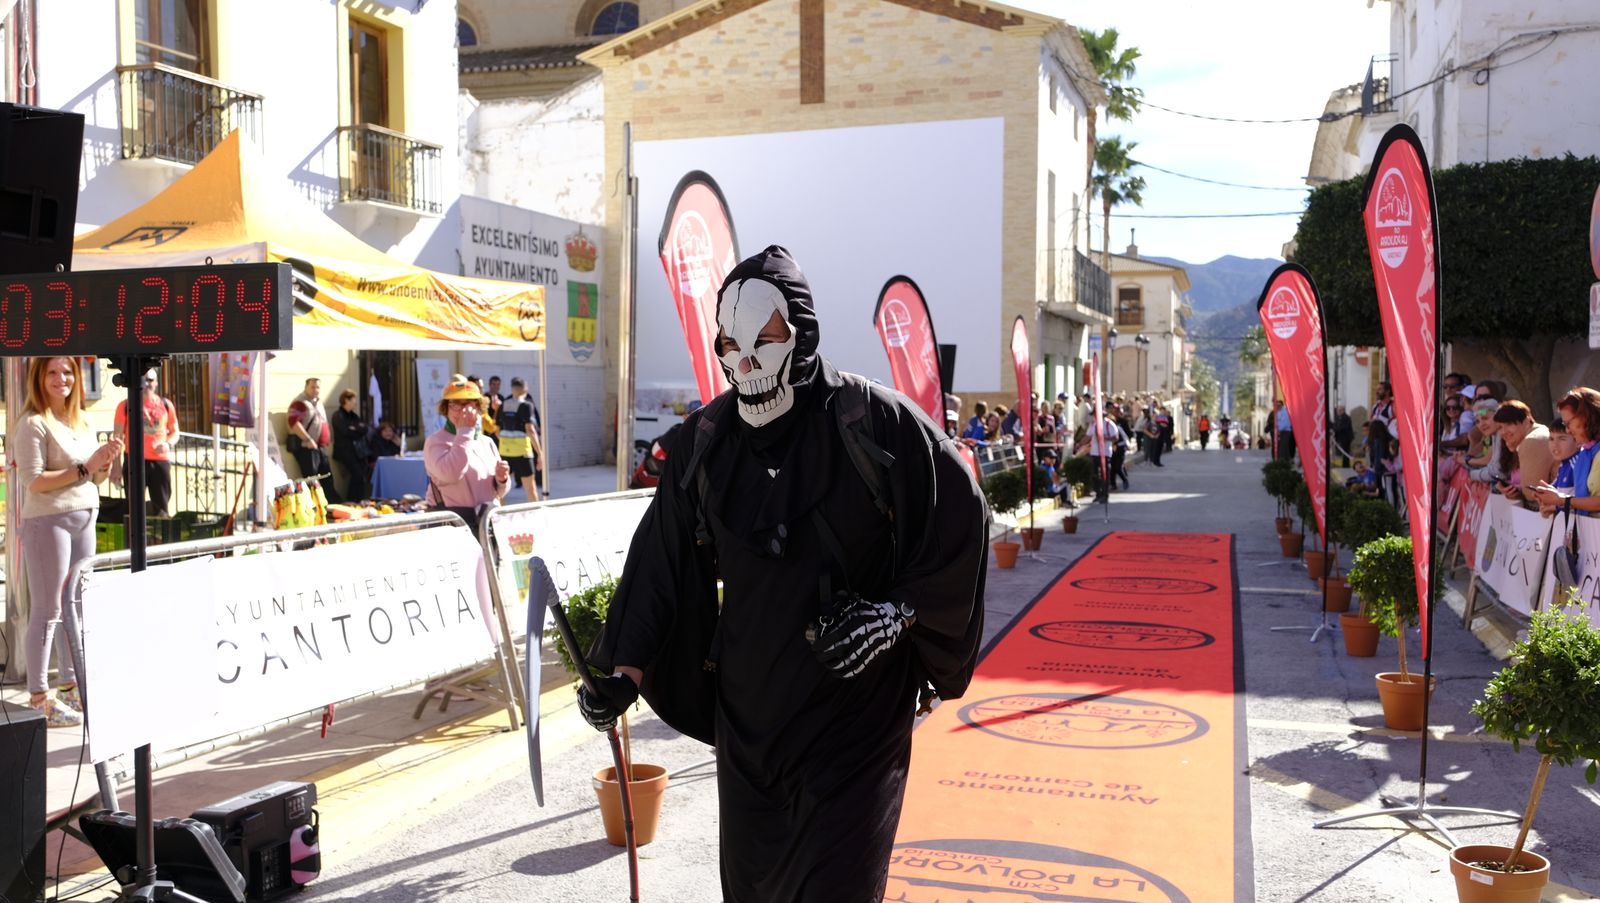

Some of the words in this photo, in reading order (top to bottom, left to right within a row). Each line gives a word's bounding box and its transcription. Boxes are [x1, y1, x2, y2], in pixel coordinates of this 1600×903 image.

[471, 224, 559, 258] EXCELENTÍSIMO
[474, 256, 559, 286] AYUNTAMIENTO
[0, 274, 272, 348] 03:12:04
[216, 568, 428, 626] YUNTAMIENTO
[436, 561, 461, 582] DE
[216, 588, 476, 684] CANTORIA
[937, 779, 1160, 805] Ayuntamiento
[963, 770, 1095, 788] Cantoria
[1104, 783, 1143, 792] de
[904, 848, 1003, 865] Cantoria
[1092, 876, 1147, 892] LA
